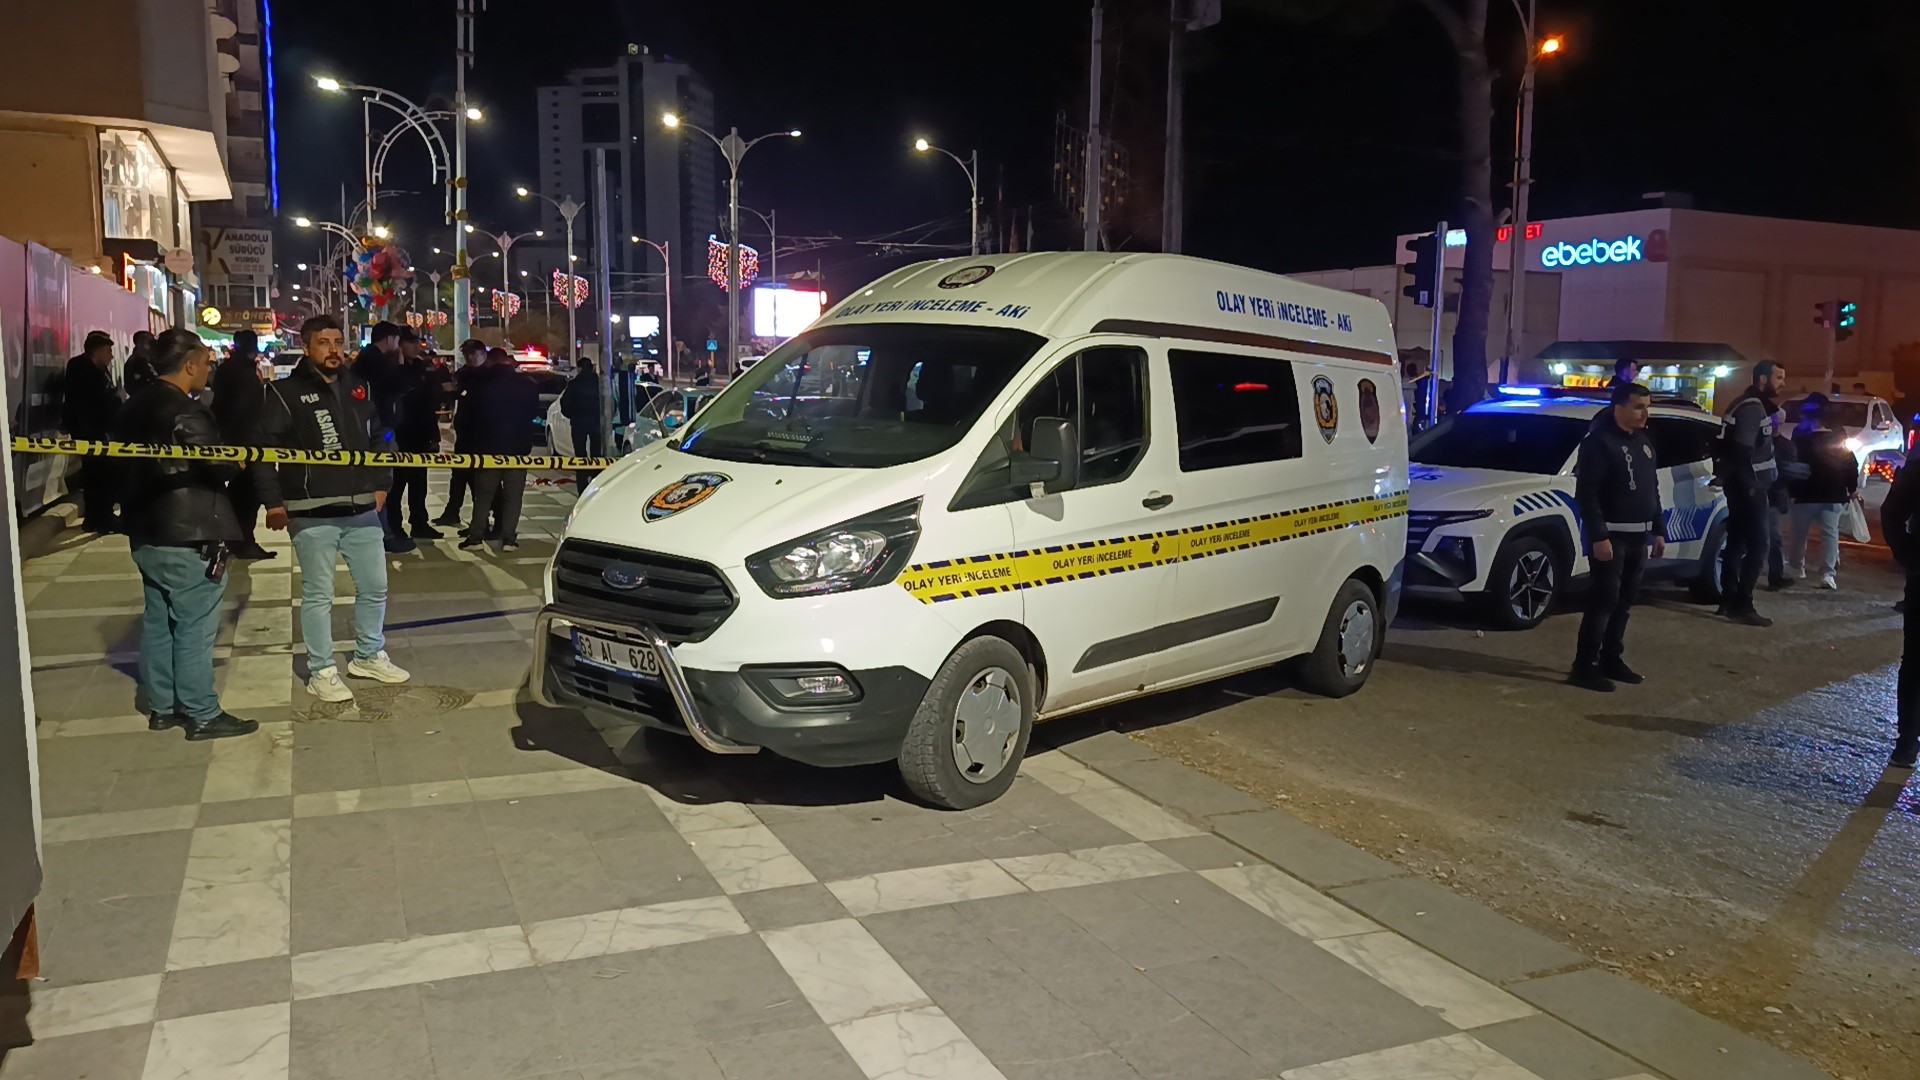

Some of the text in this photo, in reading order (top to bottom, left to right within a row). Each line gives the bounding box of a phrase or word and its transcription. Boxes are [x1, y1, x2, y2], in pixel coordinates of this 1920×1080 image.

[225, 233, 269, 243] ANADOLU
[1497, 223, 1544, 241] UET
[229, 243, 266, 255] SÜRÜCÜ
[1541, 235, 1643, 267] ebebek
[1216, 290, 1247, 314] OLAY
[1293, 518, 1307, 528] OLAY
[1190, 536, 1208, 548] OLAY
[1053, 557, 1075, 570] OLAY
[903, 577, 935, 592] OLAY
[578, 635, 593, 657] 63
[601, 640, 617, 665] AL
[628, 647, 657, 672] 628
